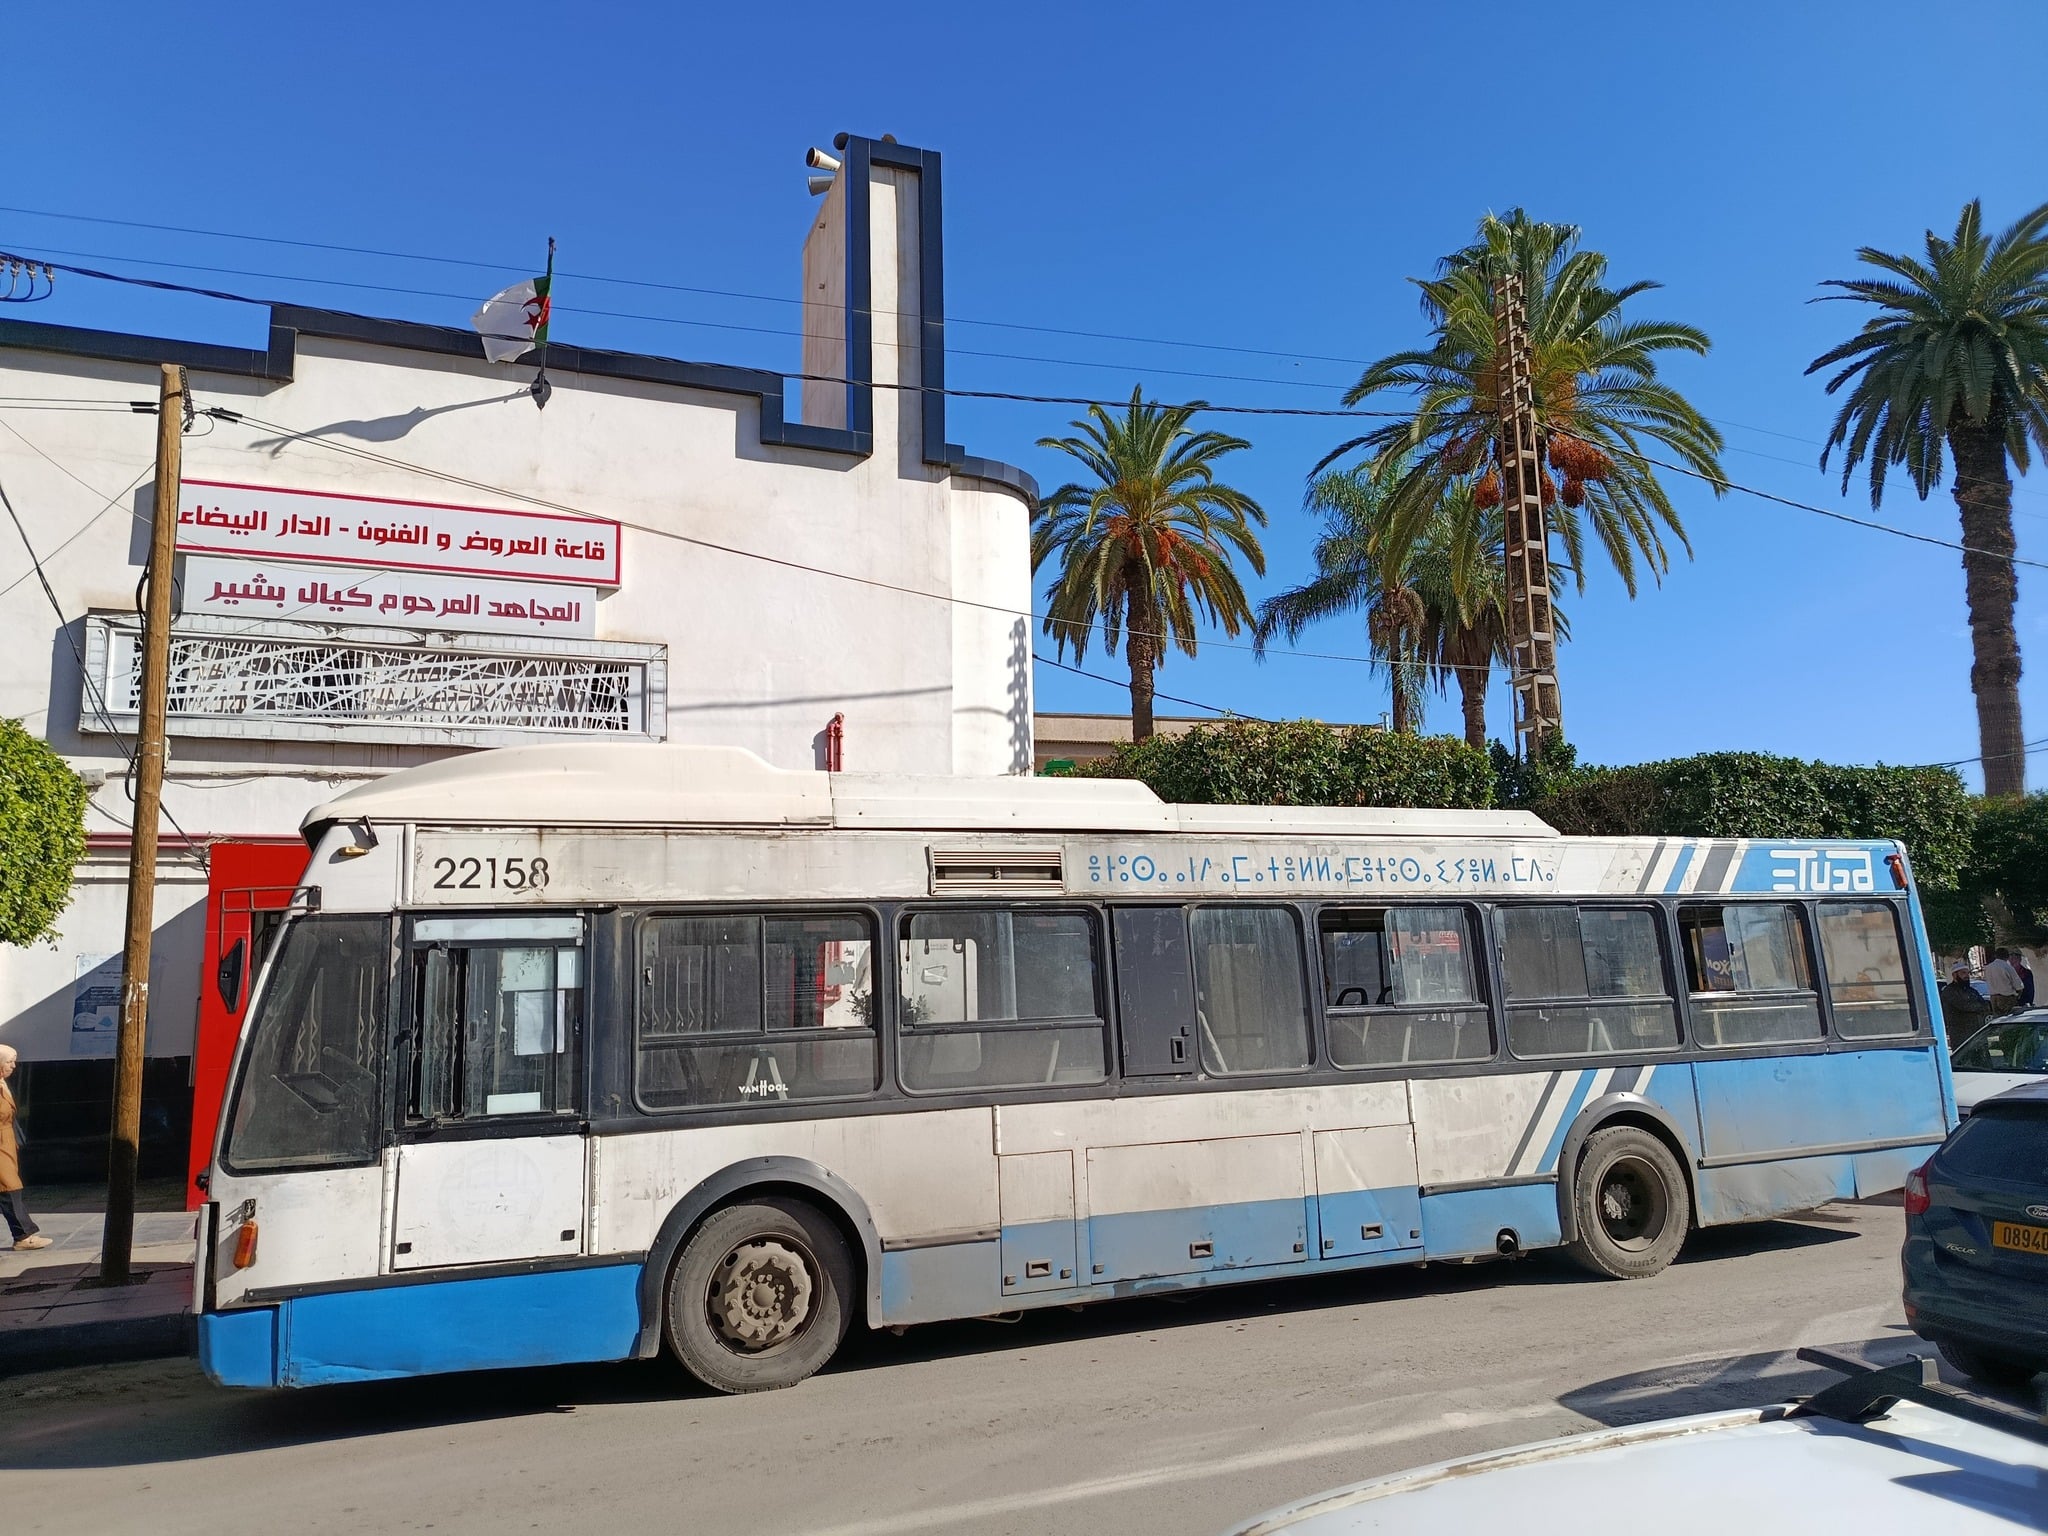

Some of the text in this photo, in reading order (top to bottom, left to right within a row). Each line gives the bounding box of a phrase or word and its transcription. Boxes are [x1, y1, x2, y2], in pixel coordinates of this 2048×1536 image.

[178, 505, 267, 536] البيضاء
[275, 513, 330, 537] الدار
[358, 520, 428, 546] الفنون
[437, 532, 451, 551] و
[459, 530, 547, 557] العروض
[554, 538, 605, 561] قاعة
[204, 573, 580, 626] المجاهد المرحوم كيال بشير
[433, 857, 549, 890] 22158
